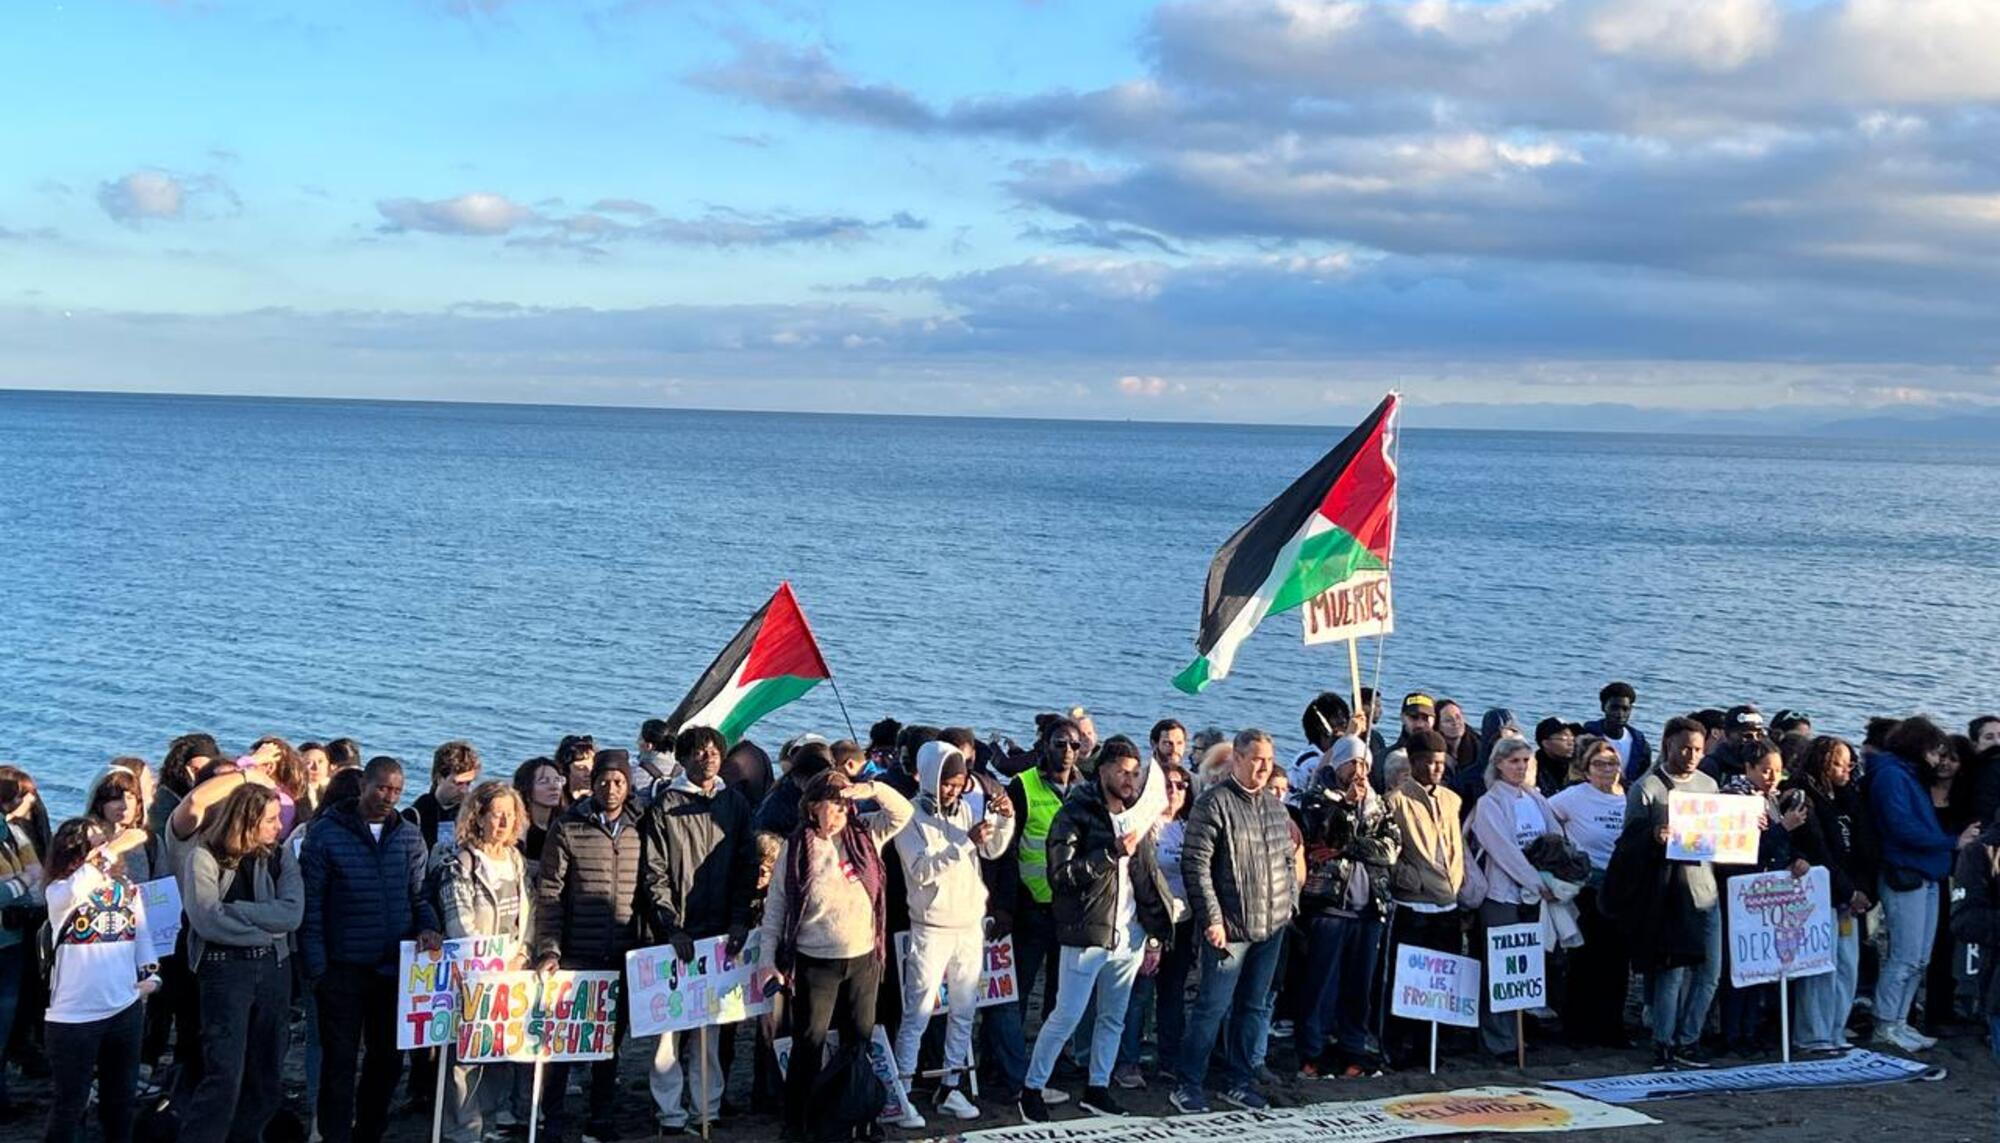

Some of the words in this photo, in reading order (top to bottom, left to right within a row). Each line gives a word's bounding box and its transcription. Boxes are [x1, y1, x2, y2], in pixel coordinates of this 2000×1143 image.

[1309, 578, 1388, 634] MUERTES
[474, 937, 504, 958] UN
[1492, 932, 1541, 950] TARAJAL
[1408, 953, 1457, 975] OUVREZ
[1506, 955, 1528, 975] NO
[1430, 976, 1447, 991] LES
[1493, 978, 1543, 1001] OLVIDAMOS
[531, 979, 620, 1023] LEGALES
[527, 1020, 616, 1056] SEGURAS
